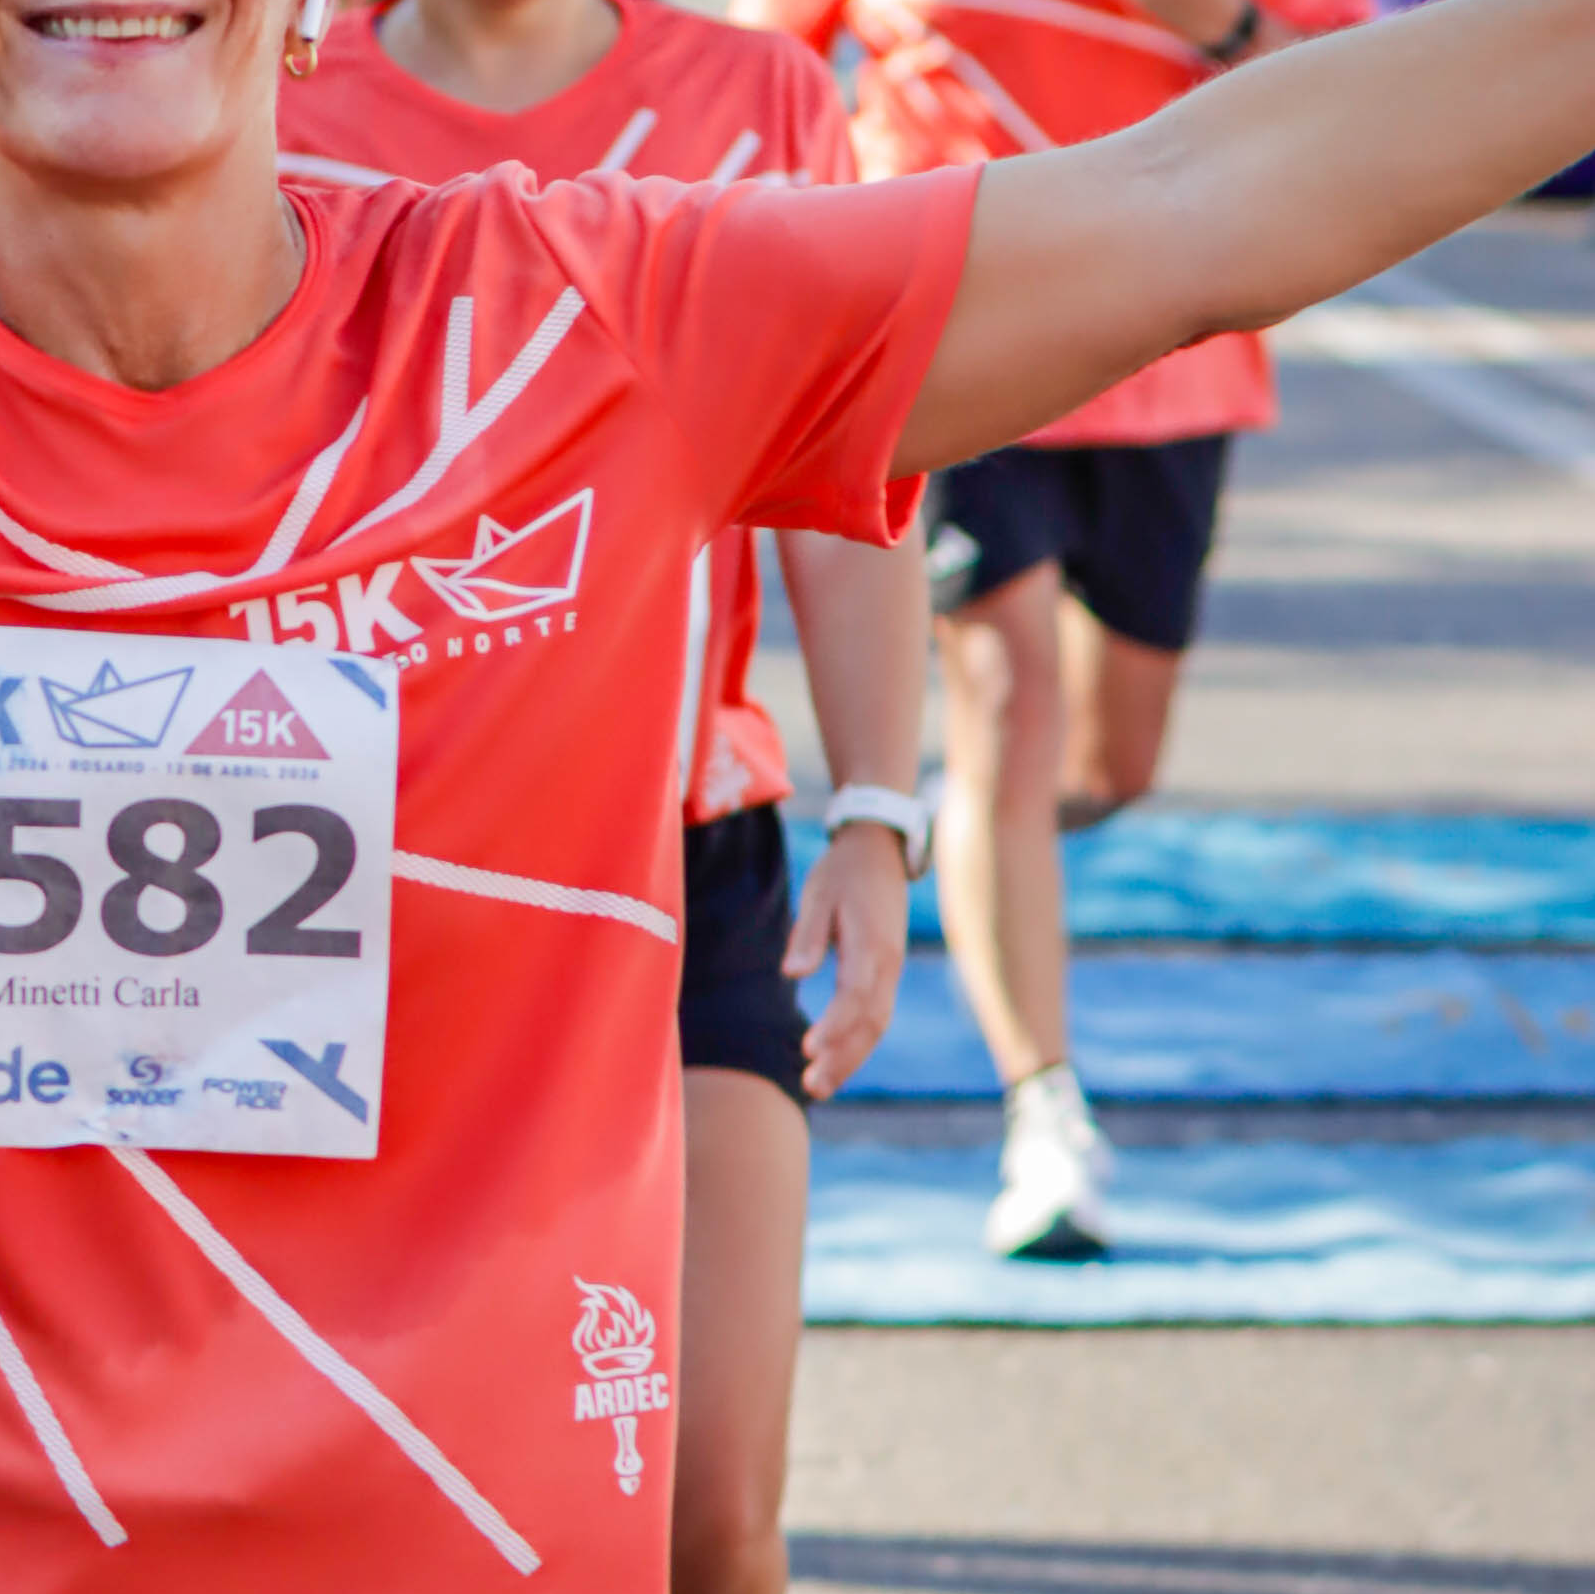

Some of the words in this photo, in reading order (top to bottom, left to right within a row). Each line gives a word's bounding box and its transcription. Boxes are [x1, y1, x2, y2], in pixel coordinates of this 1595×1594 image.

[228, 561, 424, 655] 15K
[447, 611, 578, 659] NORTE
[219, 709, 297, 747] 15K
[69, 759, 145, 774] ROSARIO
[220, 764, 270, 779] ABRIL
[113, 976, 200, 1007] Carla
[573, 1372, 670, 1422] ARDEC
